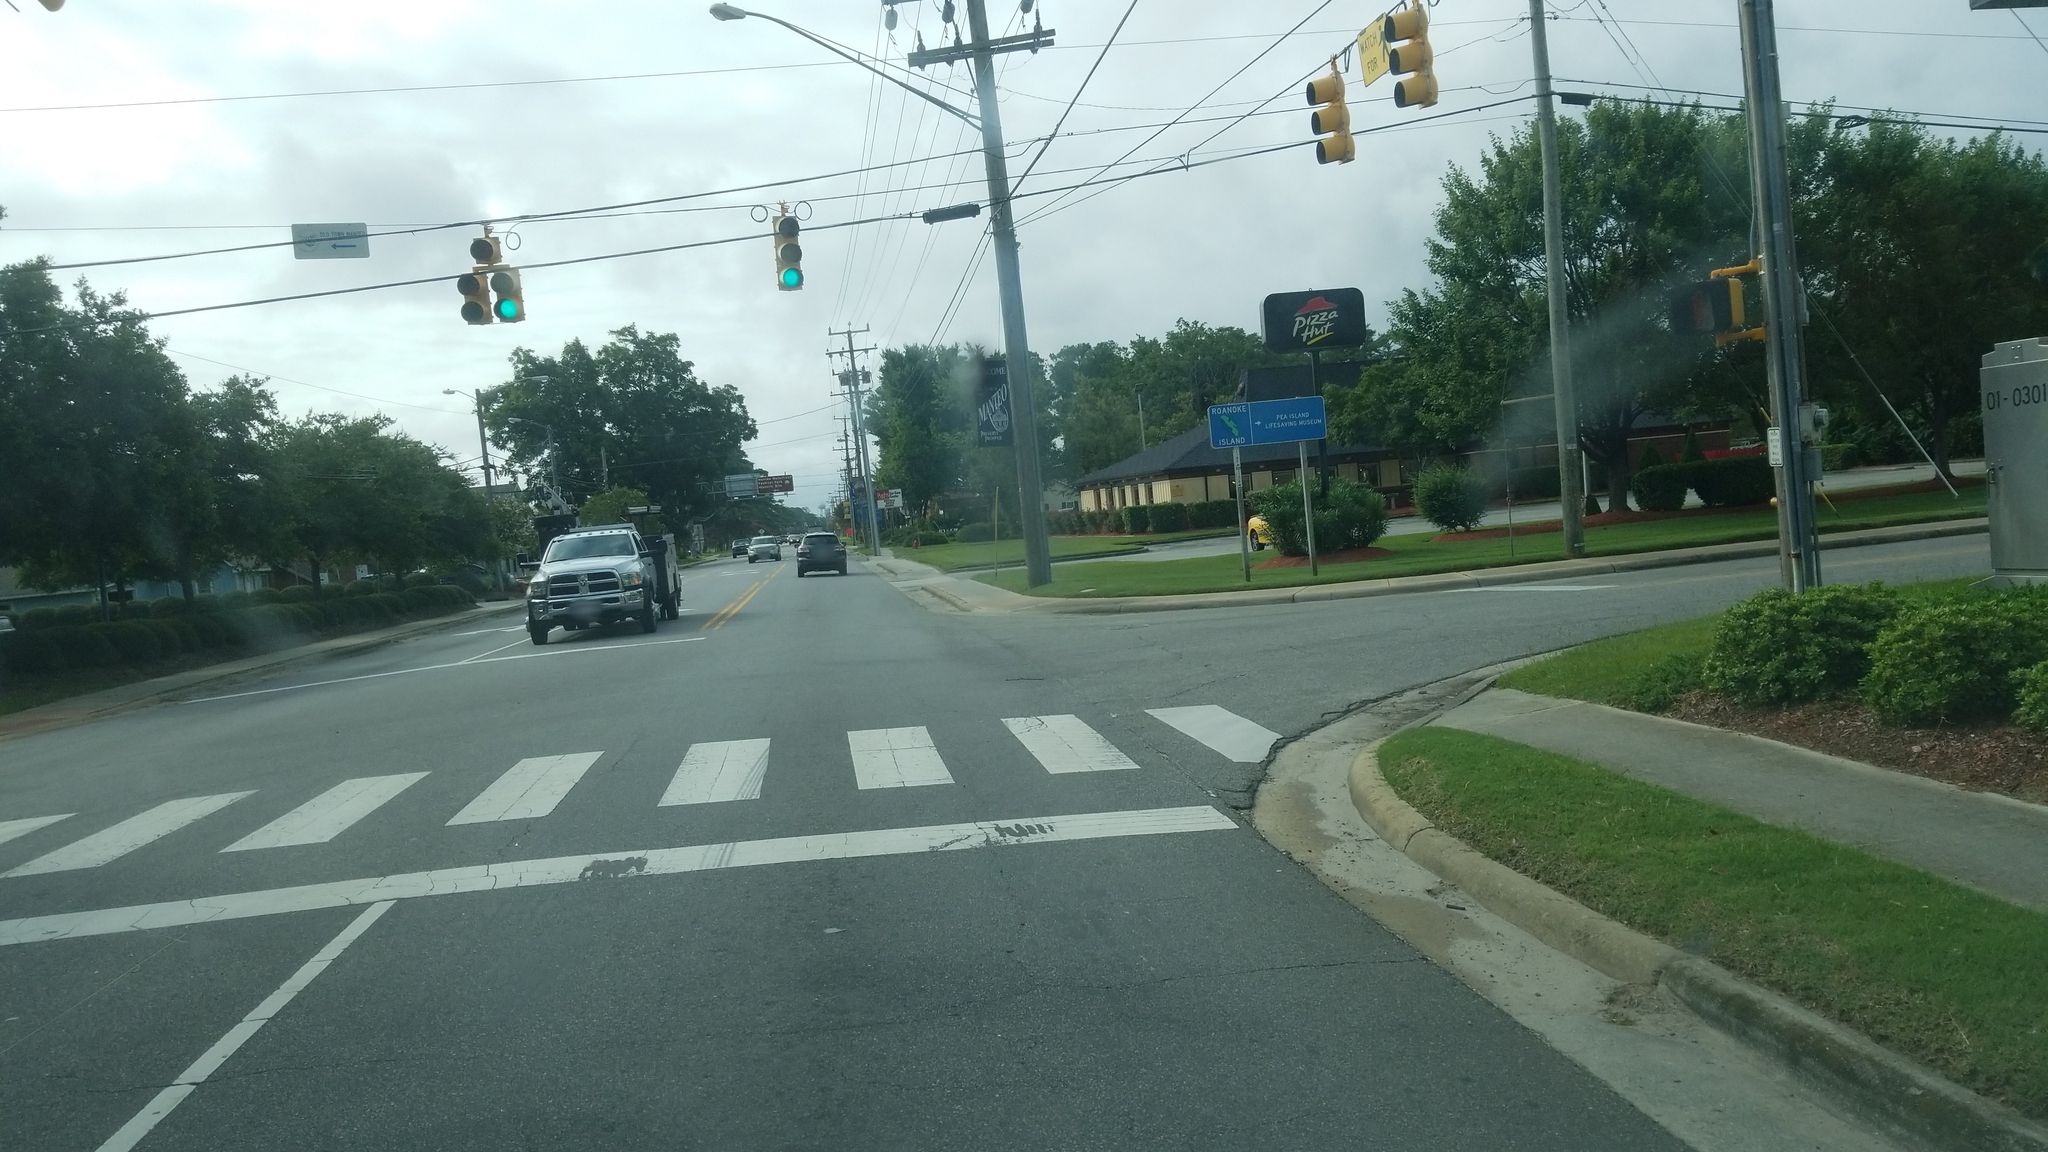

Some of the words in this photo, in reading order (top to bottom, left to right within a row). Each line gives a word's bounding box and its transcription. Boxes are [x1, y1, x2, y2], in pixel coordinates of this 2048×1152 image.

[1360, 32, 1377, 55] WATCH
[1367, 56, 1378, 74] FOR
[1292, 310, 1338, 337] Pizza
[1301, 321, 1335, 342] Hut
[978, 383, 1008, 427] MANTEO
[1211, 405, 1247, 415] ROANOKE
[1265, 420, 1298, 430] LIFESAVING
[1298, 418, 1322, 427] MUSEUM
[1219, 437, 1246, 446] ISLAND
